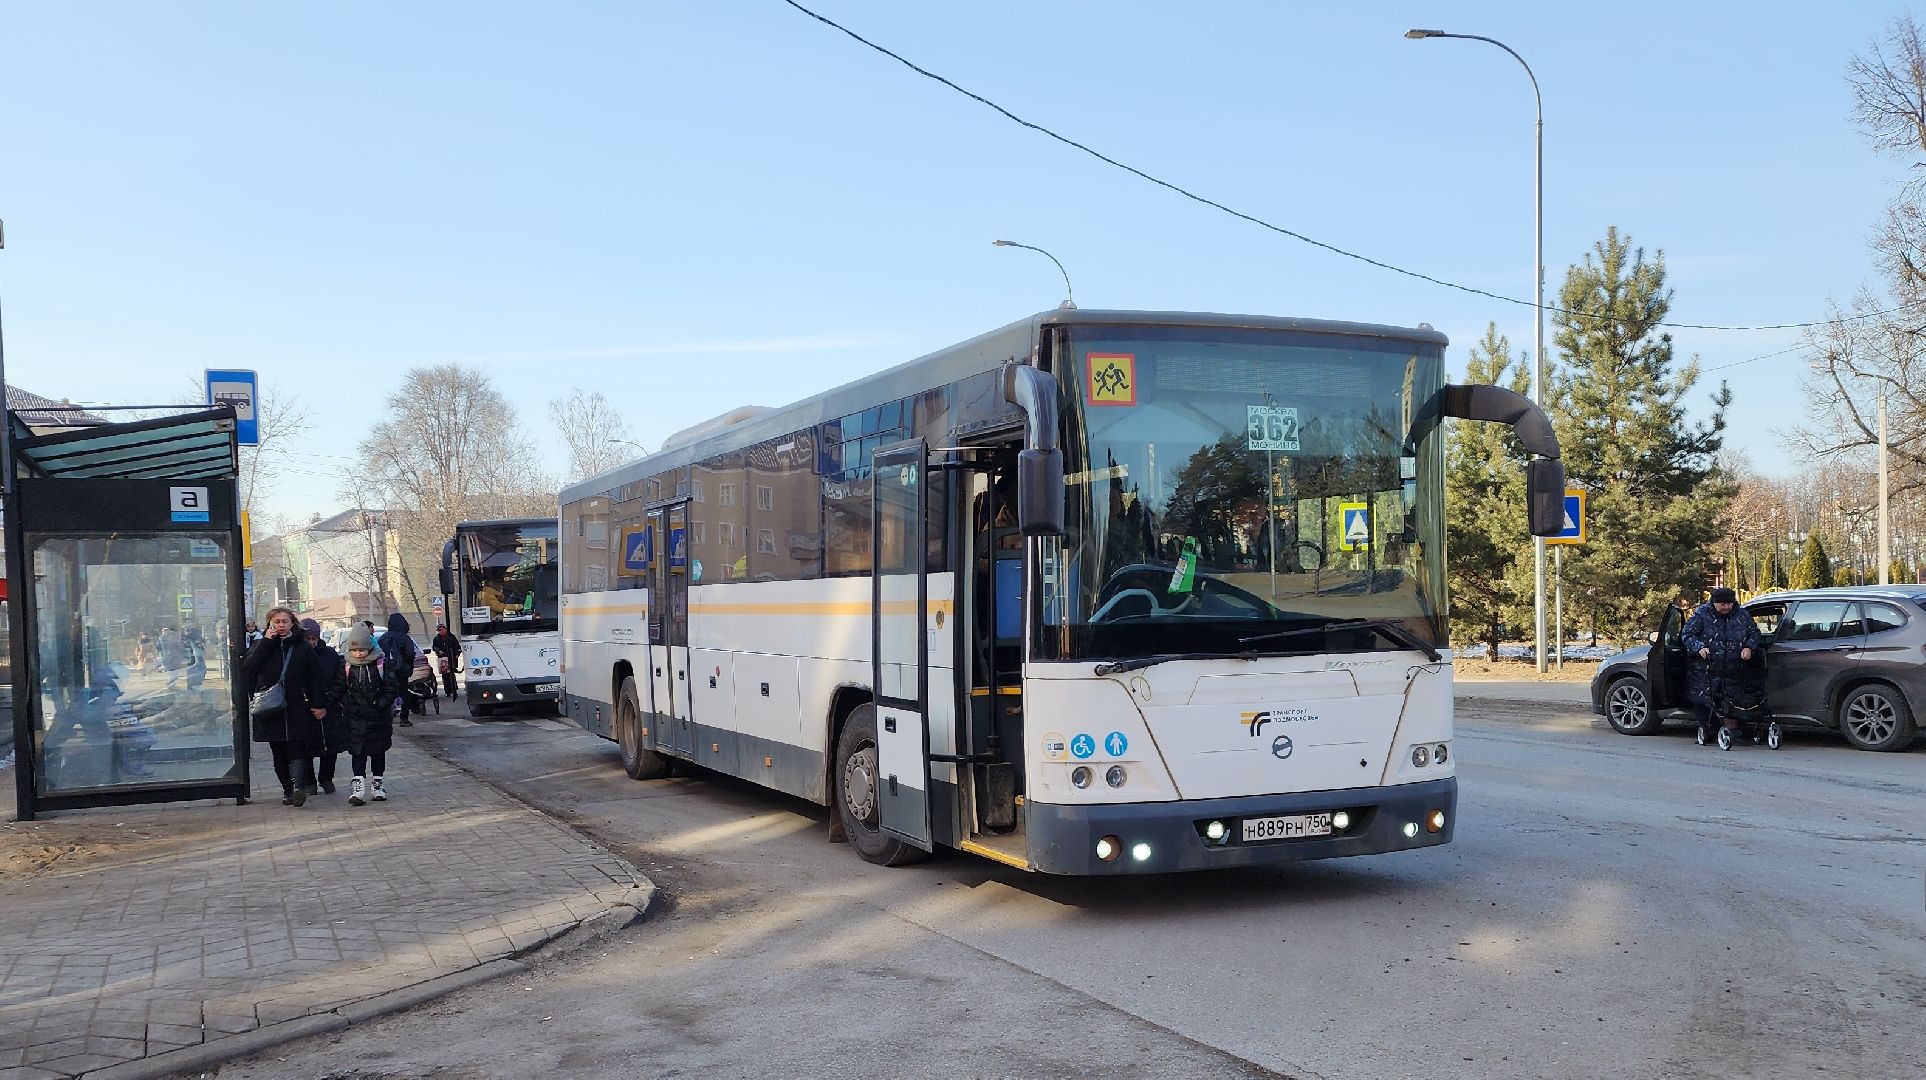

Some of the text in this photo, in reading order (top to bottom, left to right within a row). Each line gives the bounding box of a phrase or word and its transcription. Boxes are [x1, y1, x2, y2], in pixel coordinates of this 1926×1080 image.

[1250, 407, 1295, 415] МОСКВА
[1249, 414, 1298, 442] 362
[1251, 441, 1298, 449] МОНИНО
[1272, 708, 1308, 716] ТРАНСПОРТ
[1247, 815, 1327, 839] Н889РН 750
